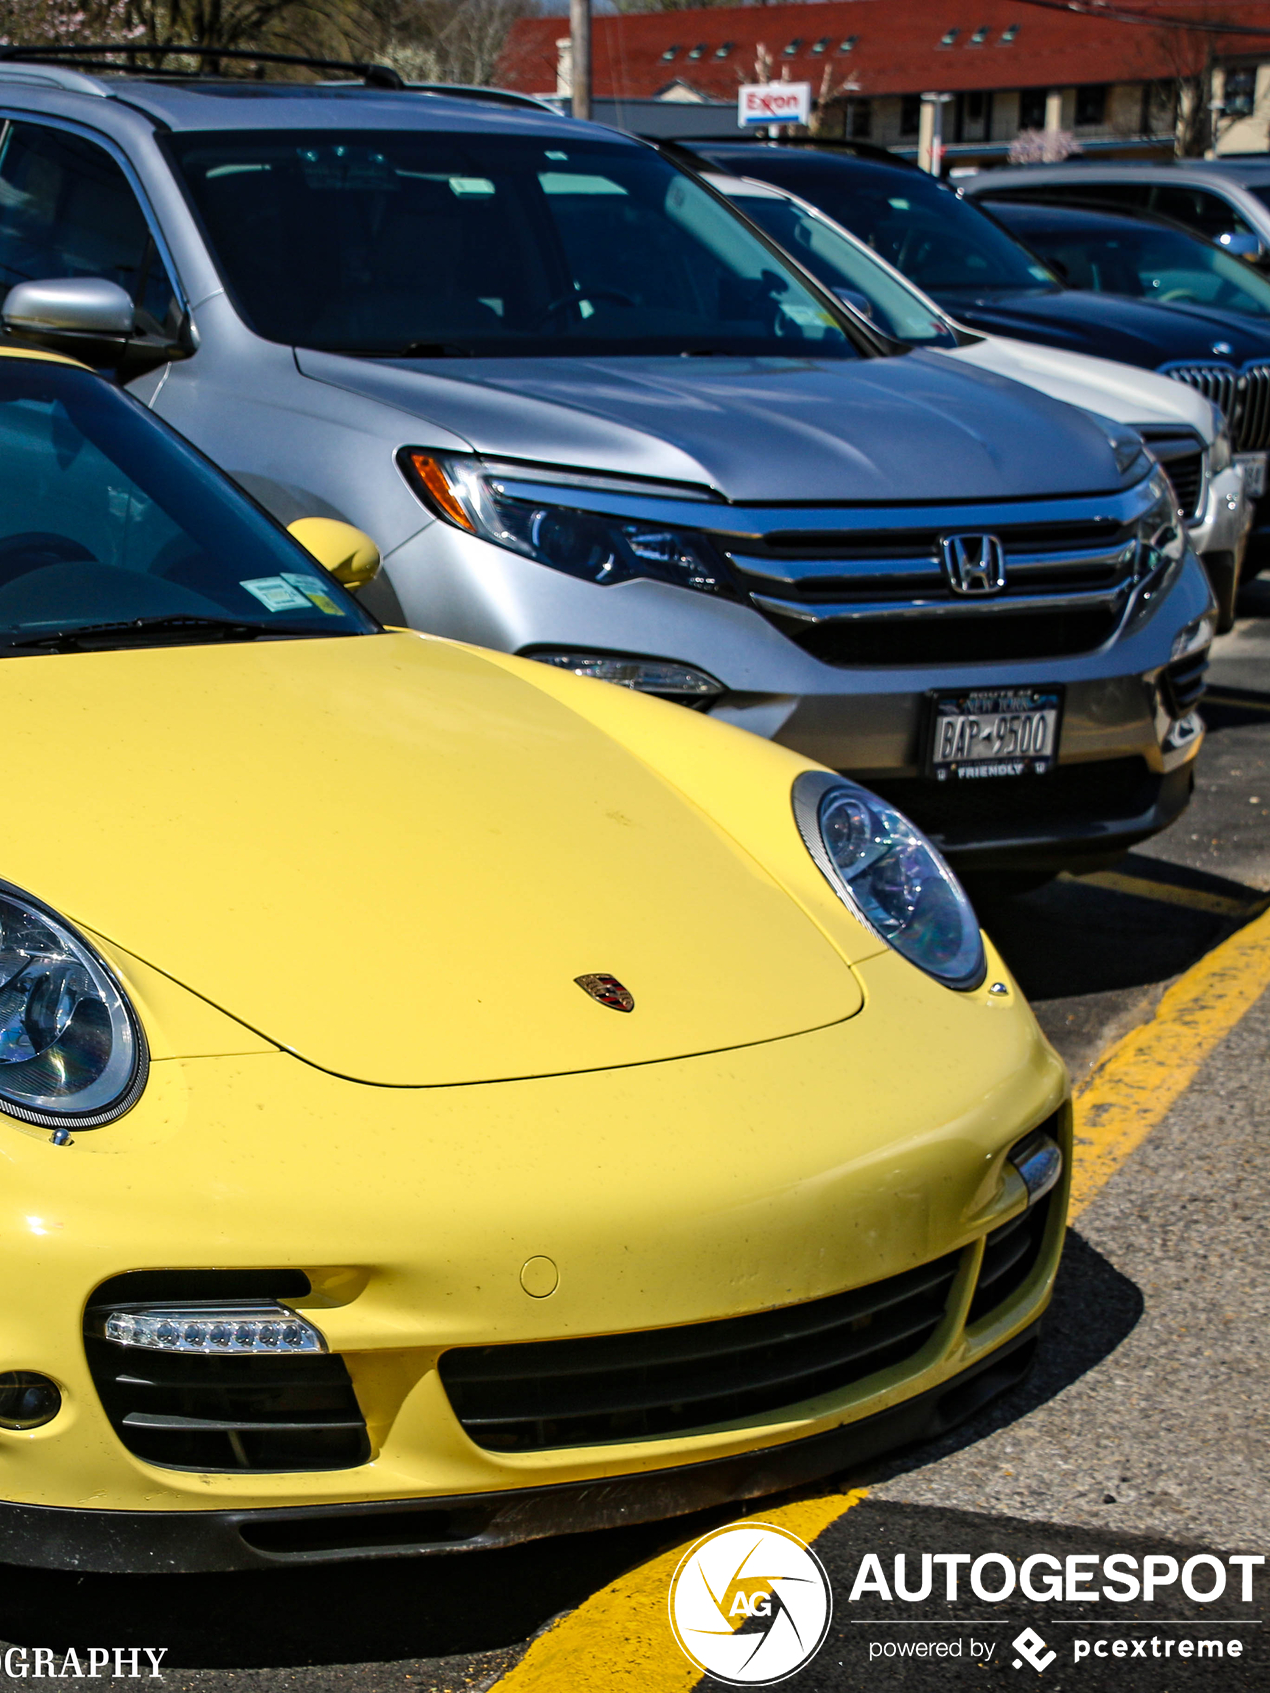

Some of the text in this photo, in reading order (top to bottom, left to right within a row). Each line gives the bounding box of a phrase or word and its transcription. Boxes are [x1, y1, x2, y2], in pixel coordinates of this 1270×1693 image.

[964, 697, 1029, 714] NEW YORK
[958, 763, 1025, 779] FRIENDLY
